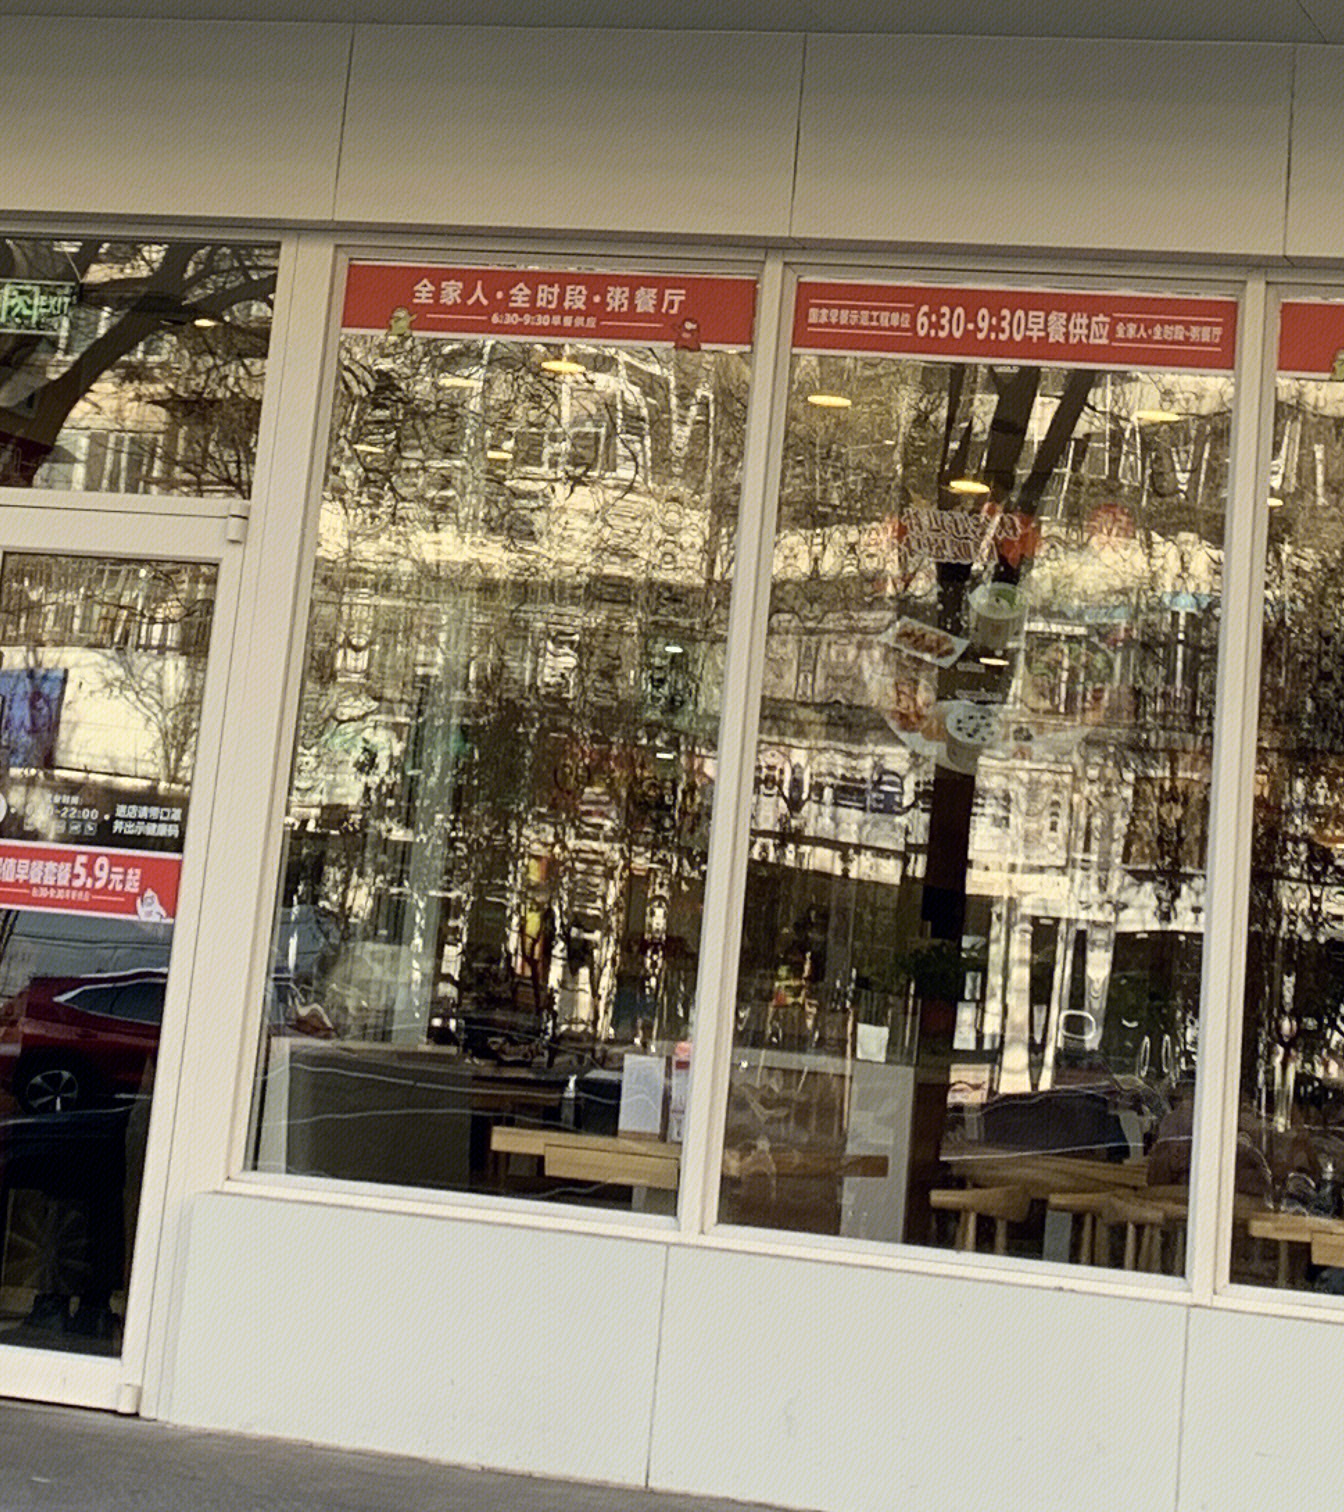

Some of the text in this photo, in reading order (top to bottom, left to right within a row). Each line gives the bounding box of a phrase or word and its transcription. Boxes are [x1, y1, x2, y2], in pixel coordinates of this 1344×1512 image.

[39, 294, 72, 315] EXIT
[491, 312, 597, 329] 6:30-9:30早餐供应
[915, 304, 1110, 346] 6:30-9:30早餐供应
